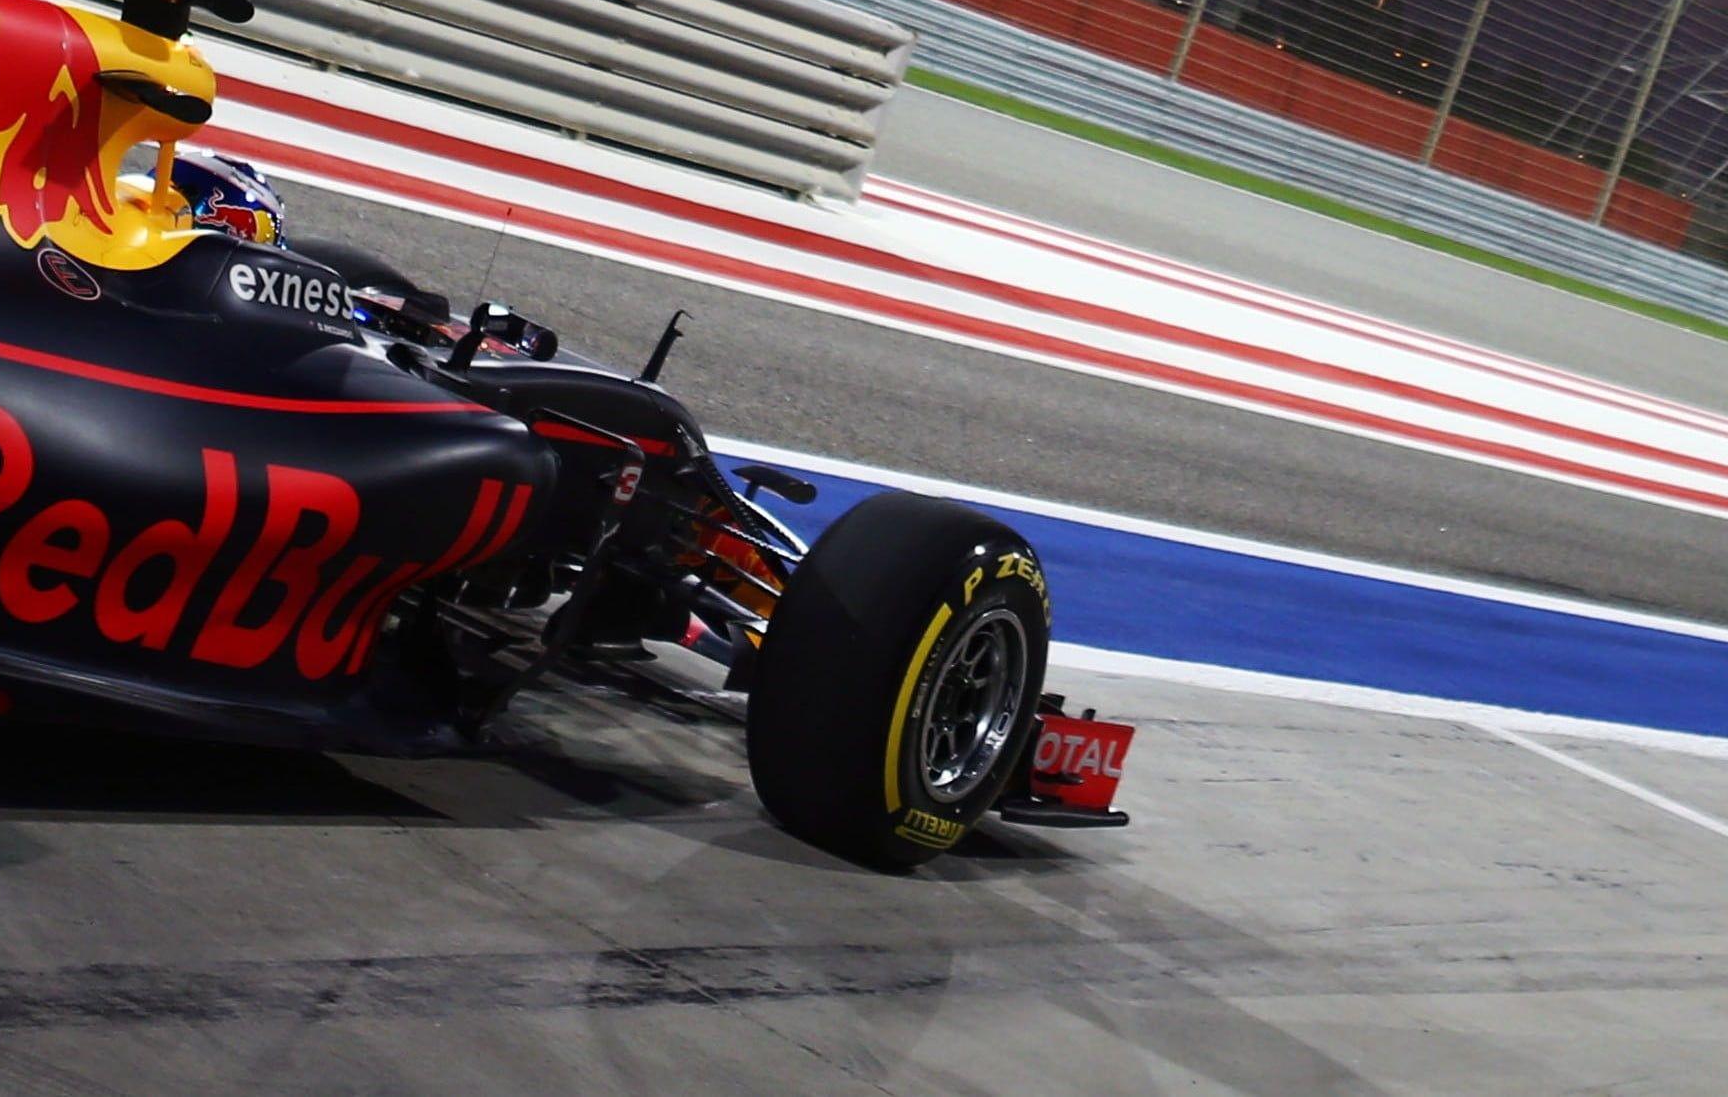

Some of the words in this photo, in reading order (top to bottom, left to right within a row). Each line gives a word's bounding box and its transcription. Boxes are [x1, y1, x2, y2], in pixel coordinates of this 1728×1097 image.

[229, 263, 354, 320] exness
[614, 465, 643, 502] 3
[963, 566, 984, 607] P
[1032, 732, 1122, 779] OTAL
